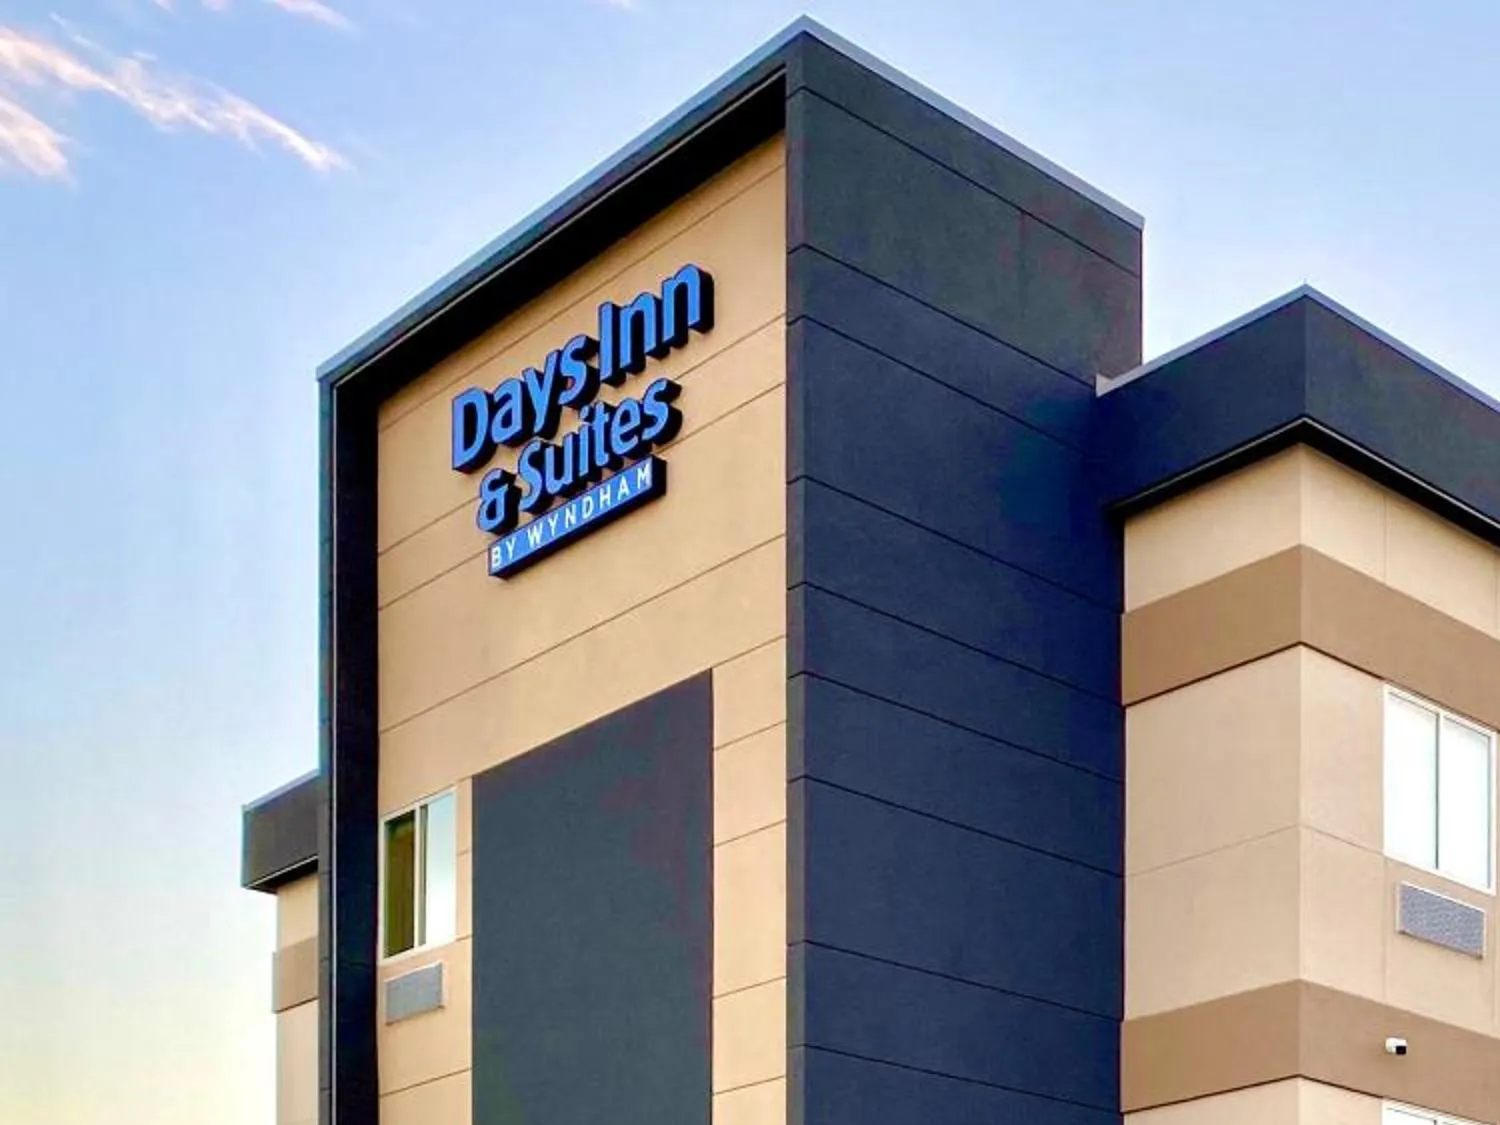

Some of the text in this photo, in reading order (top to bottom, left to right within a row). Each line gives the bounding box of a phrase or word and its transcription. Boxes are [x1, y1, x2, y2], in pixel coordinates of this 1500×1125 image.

[452, 264, 714, 474] Days Inn
[476, 378, 682, 535] & Suites
[491, 462, 653, 568] BY WYNDHAM
